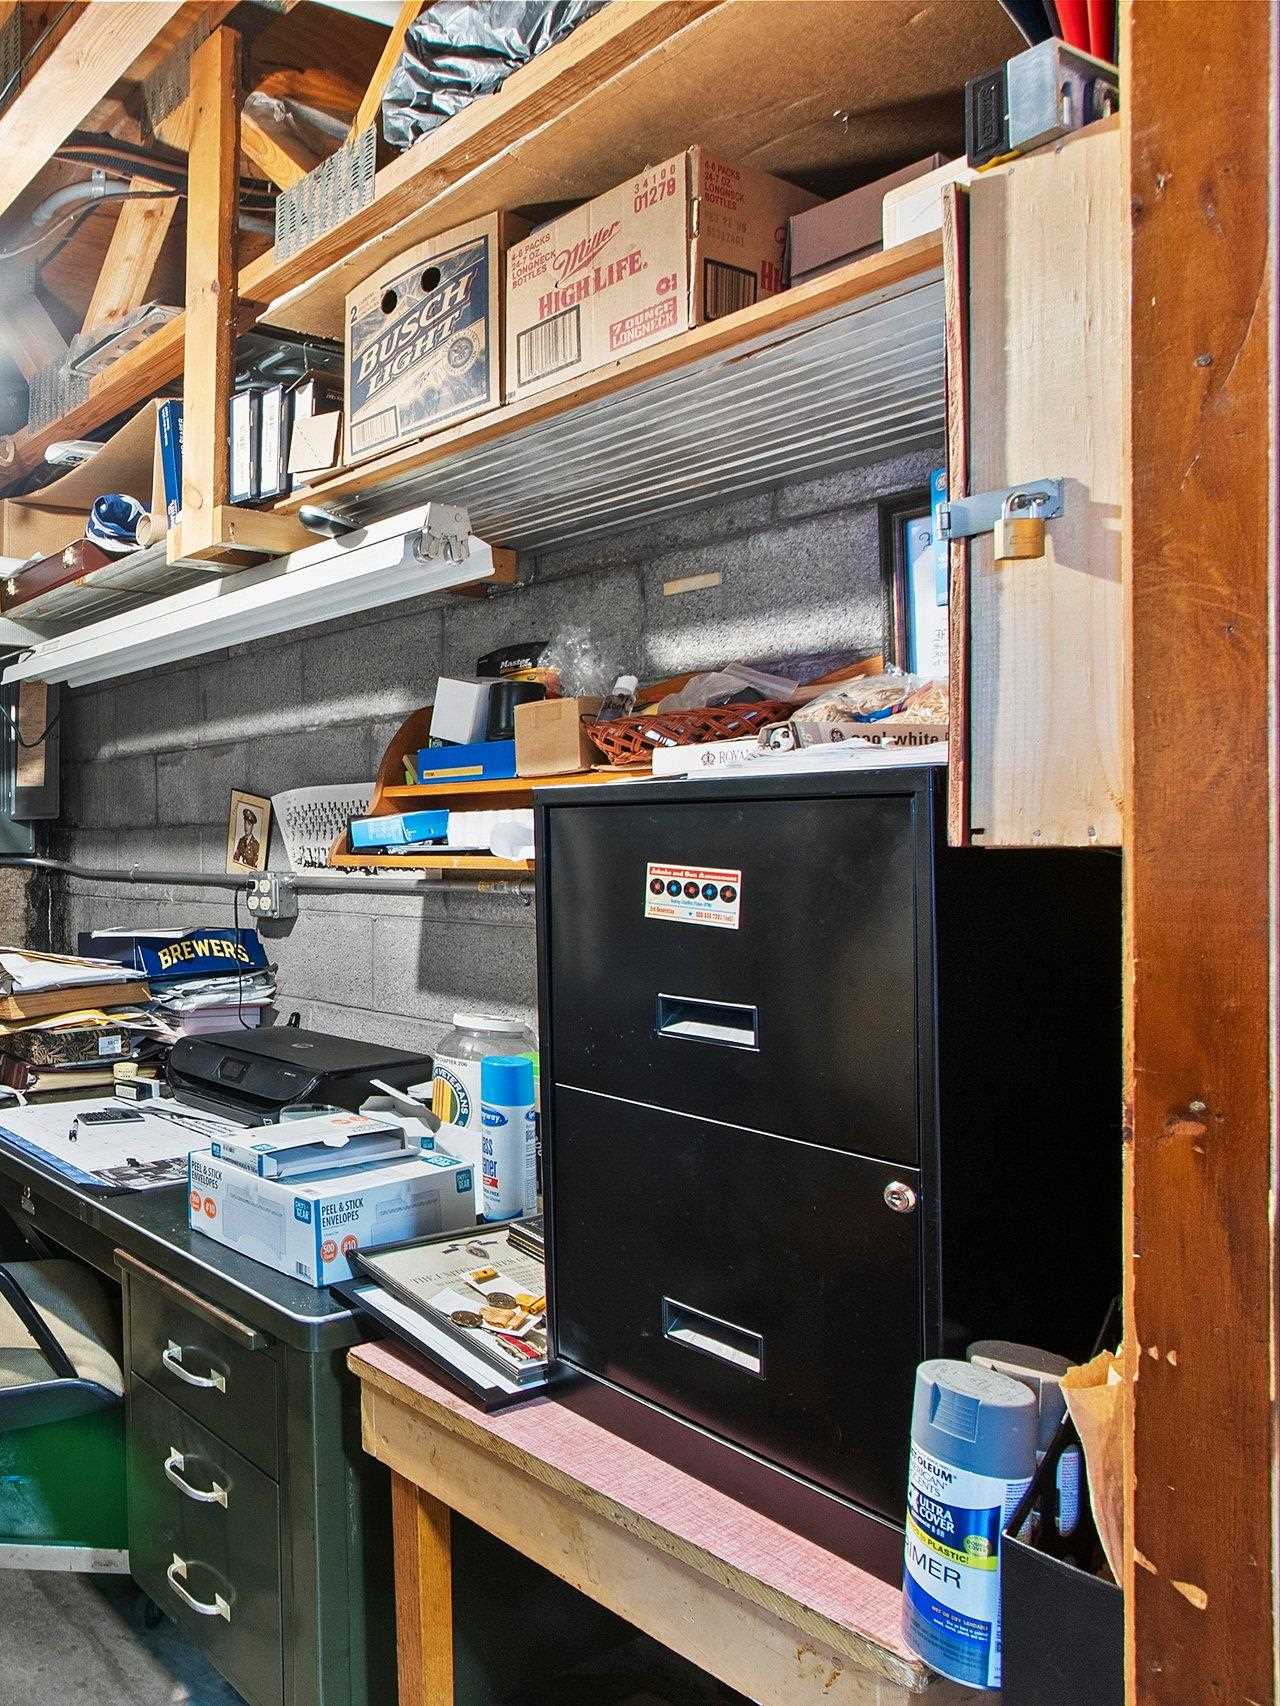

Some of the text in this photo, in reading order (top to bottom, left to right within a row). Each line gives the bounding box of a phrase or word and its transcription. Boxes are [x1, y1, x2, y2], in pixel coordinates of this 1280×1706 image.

[524, 233, 551, 253] PACKS
[553, 220, 621, 288] Miller
[511, 249, 556, 280] LONGNECK
[511, 264, 548, 290] BOTTLES
[538, 250, 642, 320] HIGH LIFE
[357, 271, 476, 385] BUSCH
[624, 300, 674, 328] OUNCE
[611, 311, 675, 350] LONGNECK
[366, 304, 464, 398] LIGHT
[892, 732, 939, 746] white
[158, 939, 250, 970] BREWERS
[438, 1067, 470, 1117] VETERANS
[191, 1160, 203, 1175] PEEL
[208, 1167, 223, 1182] STICK
[191, 1171, 219, 1190] ENVELOPES
[321, 1202, 338, 1216] PEEL
[339, 1201, 344, 1211] &
[345, 1198, 364, 1211] STICK
[322, 1210, 360, 1228] ENVELOPES
[920, 1493, 953, 1523] ULTRA
[920, 1507, 955, 1534] COVER
[927, 1537, 970, 1564] PLASTIC!
